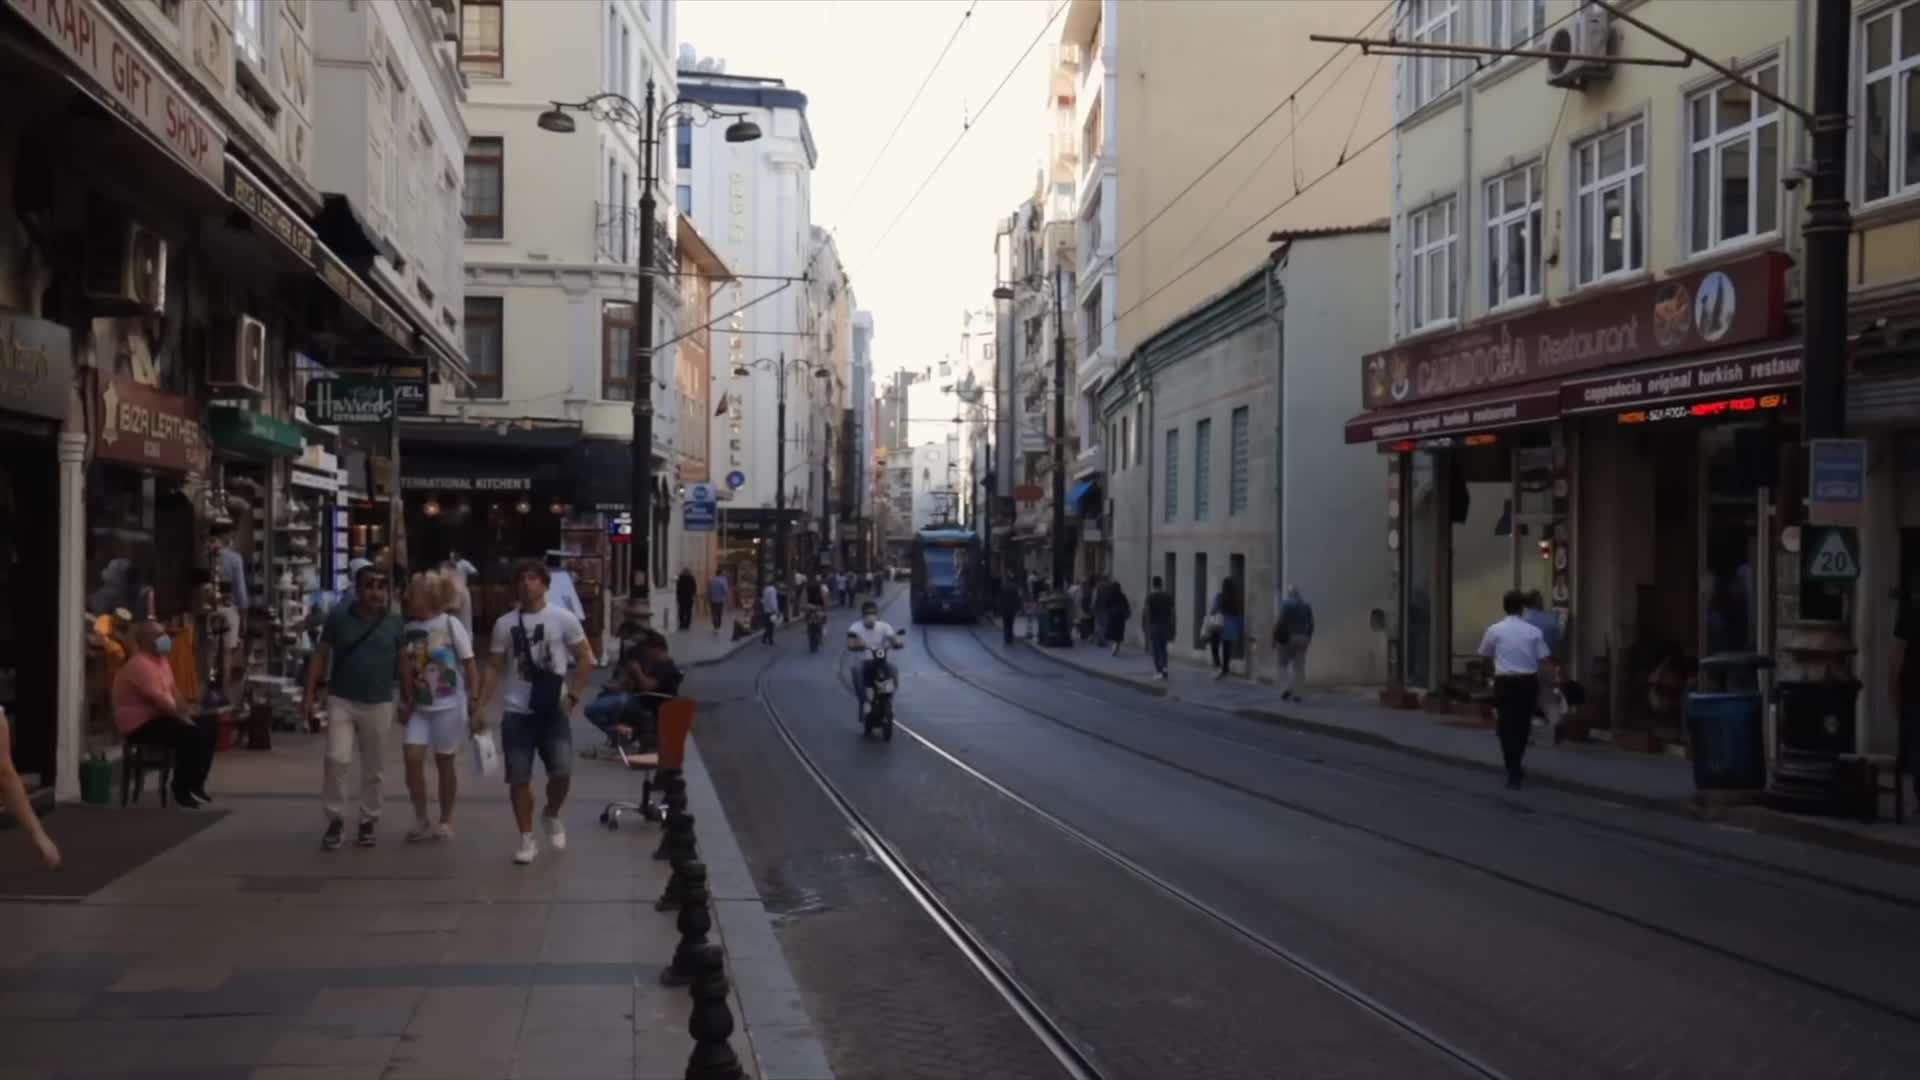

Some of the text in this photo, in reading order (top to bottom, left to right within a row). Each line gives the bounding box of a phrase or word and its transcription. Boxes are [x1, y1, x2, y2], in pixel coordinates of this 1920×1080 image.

[21, 0, 209, 162] KAPI GIFT SHOP
[1538, 315, 1639, 367] Restaurant
[1648, 370, 1693, 395] original
[1698, 364, 1743, 386] turkish
[308, 381, 393, 418] Harrods
[1821, 551, 1847, 572] 20
